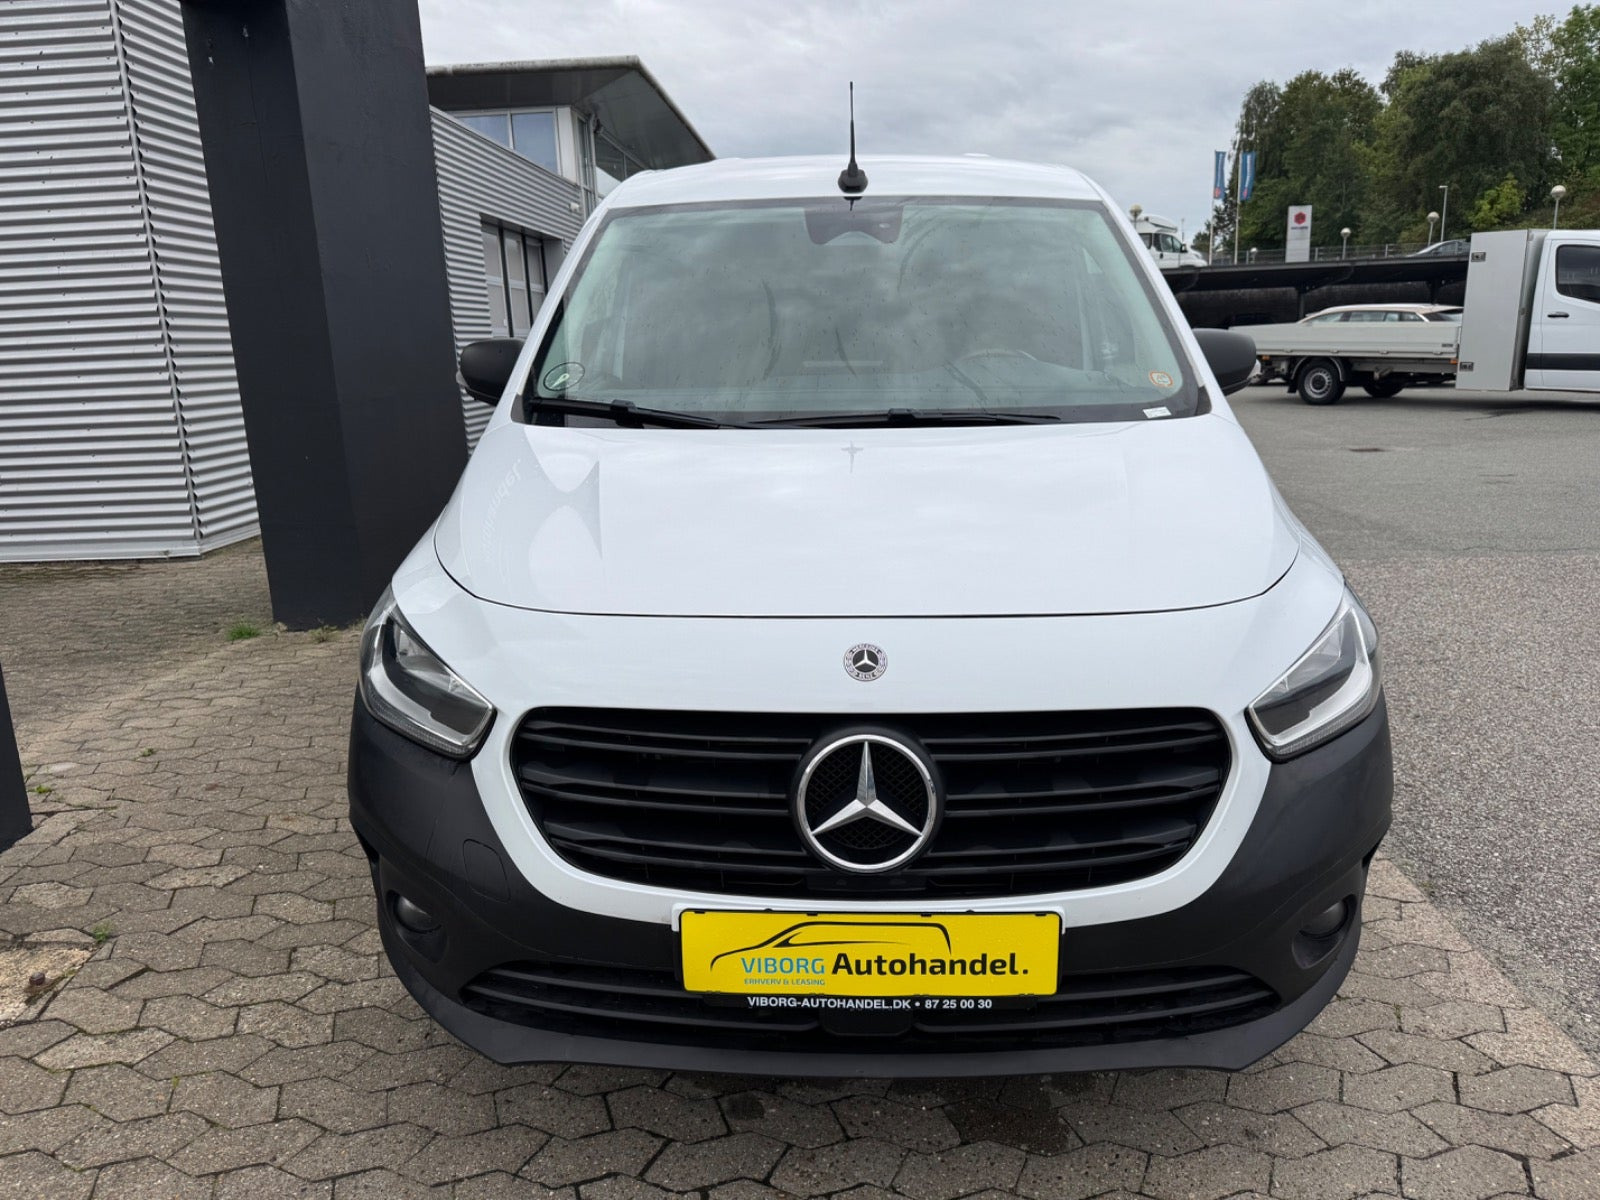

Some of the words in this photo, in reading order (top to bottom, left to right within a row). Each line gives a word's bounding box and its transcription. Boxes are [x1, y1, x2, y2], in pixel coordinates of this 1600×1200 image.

[741, 957, 825, 974] VIBORG
[831, 952, 1029, 976] Autohandel.
[747, 996, 912, 1010] VIBORG-AUTOHANDEL.DK
[924, 999, 938, 1009] 87
[942, 999, 957, 1009] 25
[959, 999, 975, 1009] 00
[977, 999, 993, 1009] 30
